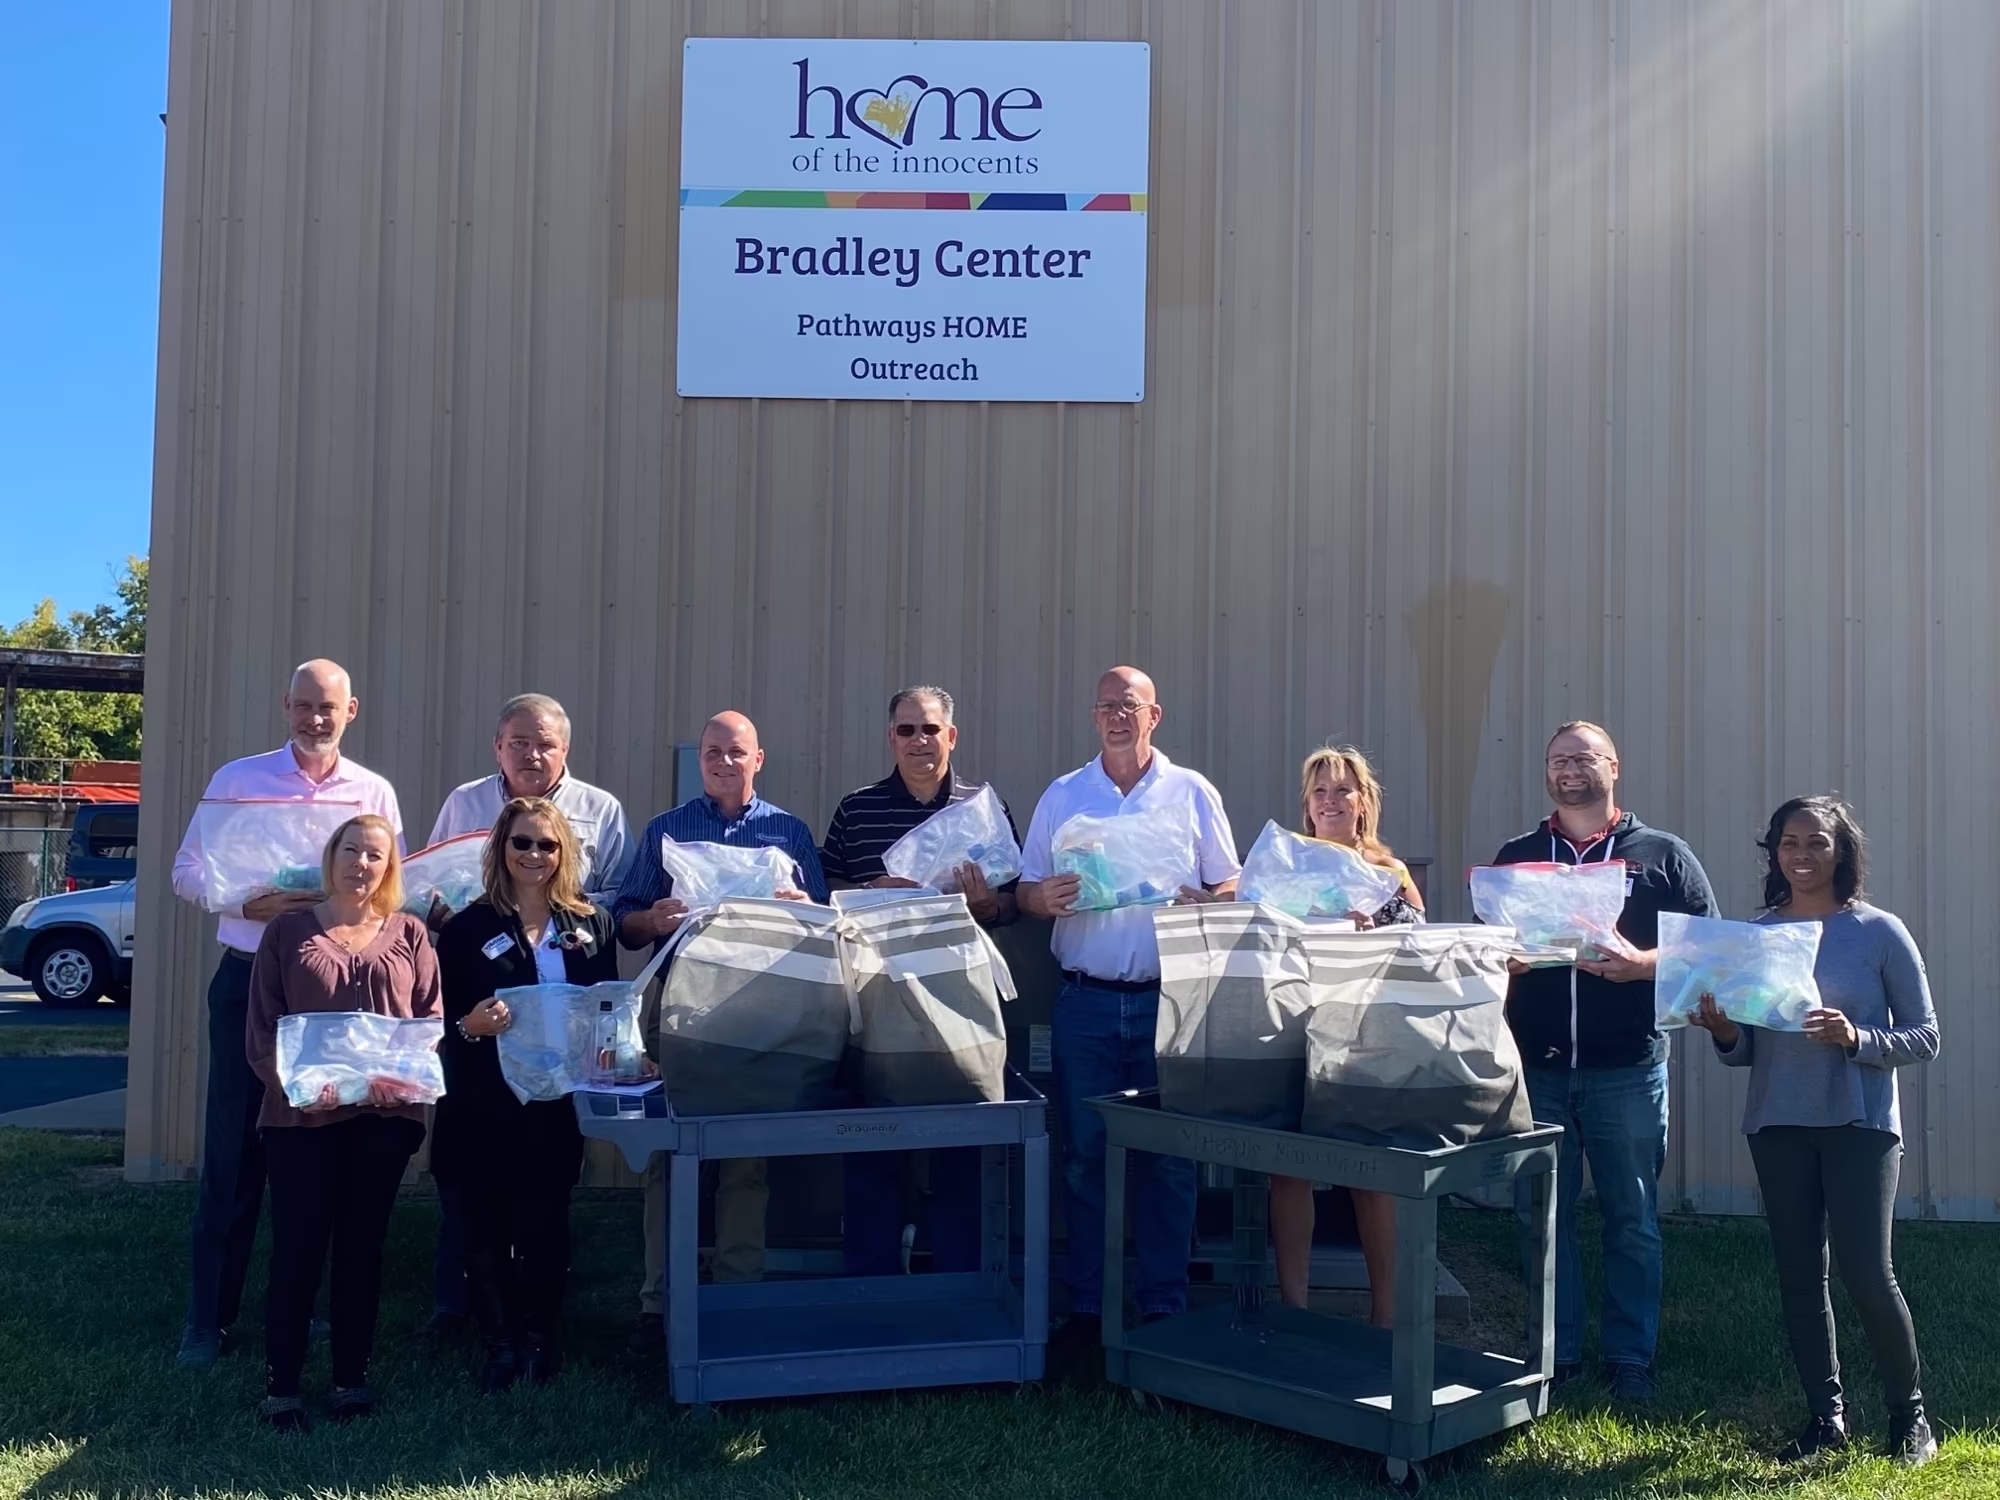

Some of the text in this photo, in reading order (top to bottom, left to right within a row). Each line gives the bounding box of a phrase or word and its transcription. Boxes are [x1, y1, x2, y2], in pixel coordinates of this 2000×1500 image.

[790, 57, 1042, 150] home
[792, 147, 1038, 175] of the innocents
[735, 237, 1090, 287] Bradley Center
[797, 314, 1028, 344] Pathways HOME
[850, 357, 979, 381] Outreach
